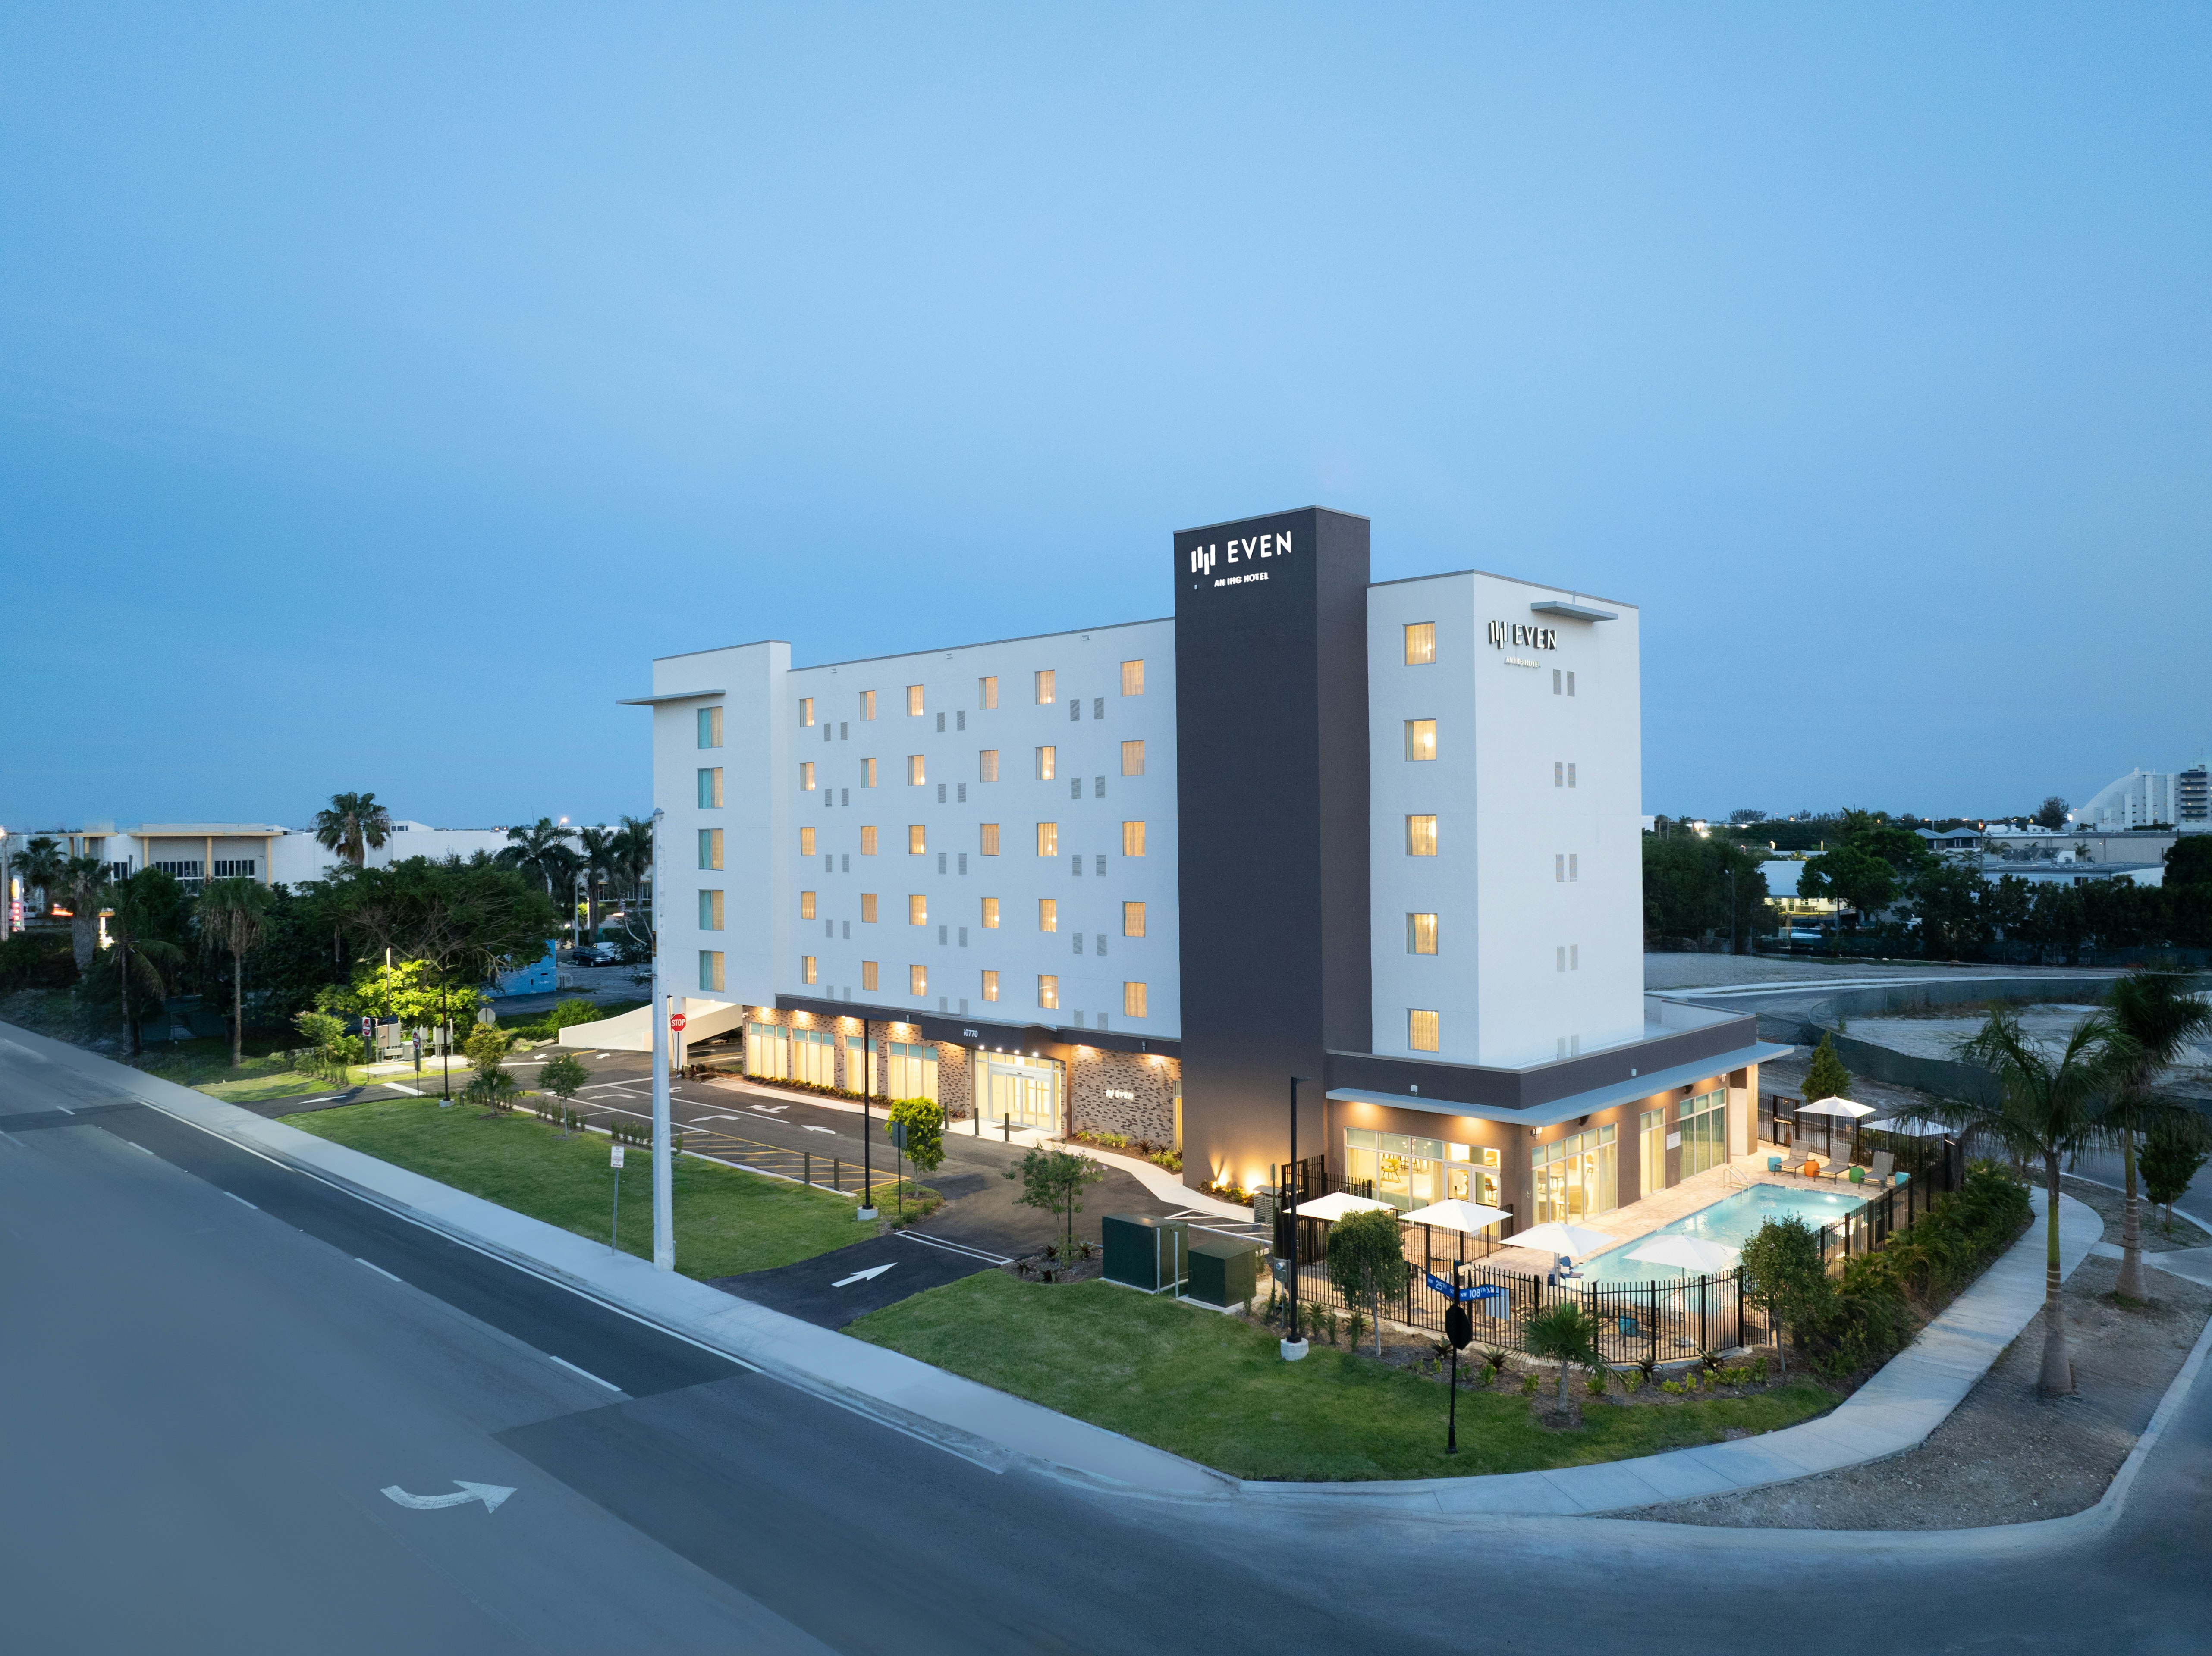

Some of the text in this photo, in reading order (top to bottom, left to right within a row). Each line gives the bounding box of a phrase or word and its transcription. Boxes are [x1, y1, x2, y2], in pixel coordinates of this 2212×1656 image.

[1228, 531, 1291, 563] EVEN
[1214, 572, 1269, 587] AN IHG HOTEL
[1513, 624, 1557, 649] EVEN
[964, 1029, 978, 1038] 10770
